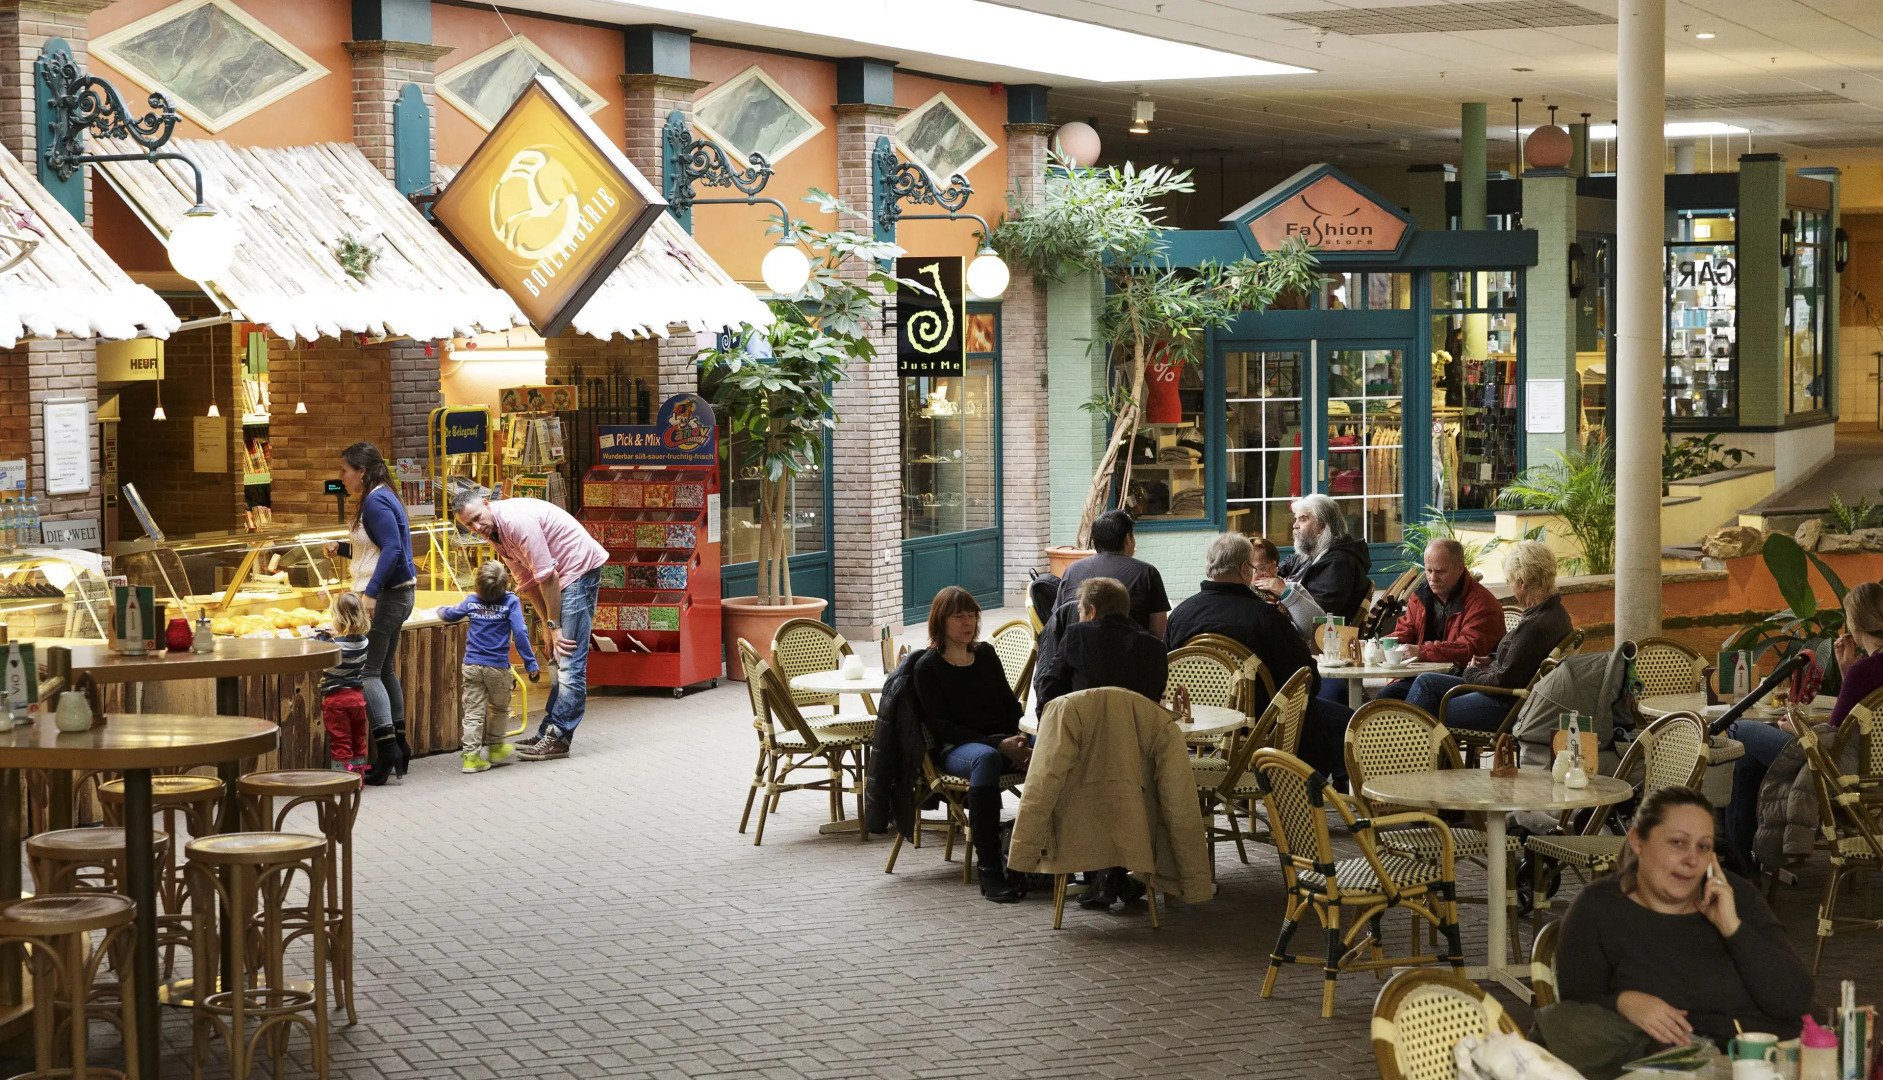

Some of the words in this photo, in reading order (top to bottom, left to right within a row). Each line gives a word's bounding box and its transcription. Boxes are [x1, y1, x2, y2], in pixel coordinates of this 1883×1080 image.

[522, 187, 616, 298] BOULANGERIE
[900, 361, 936, 370] Just
[940, 361, 960, 370] Me
[452, 424, 479, 438] Telegraaf
[664, 425, 710, 448] Candy
[616, 433, 633, 446] Pick
[634, 433, 643, 446] &
[644, 433, 661, 446] Mix
[46, 530, 64, 543] DIE
[72, 527, 97, 541] WELT
